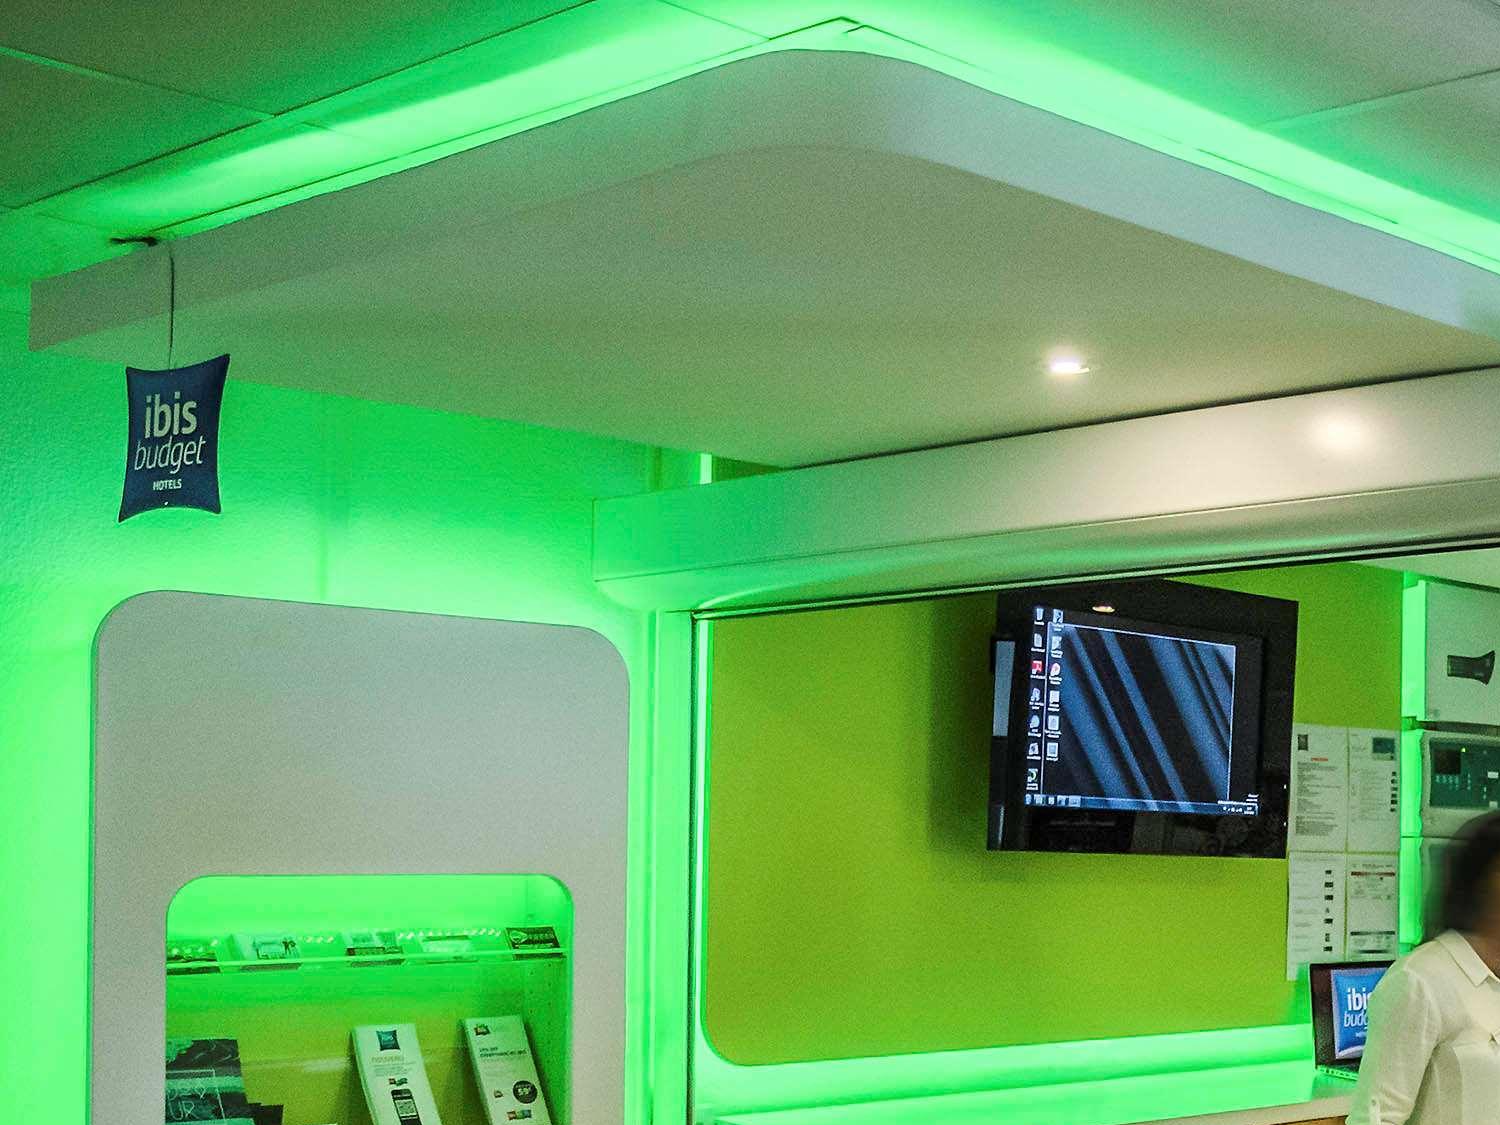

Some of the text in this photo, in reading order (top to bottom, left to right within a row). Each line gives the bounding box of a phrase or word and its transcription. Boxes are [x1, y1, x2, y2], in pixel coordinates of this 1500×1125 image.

[144, 391, 198, 439] ibis
[134, 435, 206, 474] budget
[152, 478, 182, 491] HOTELS
